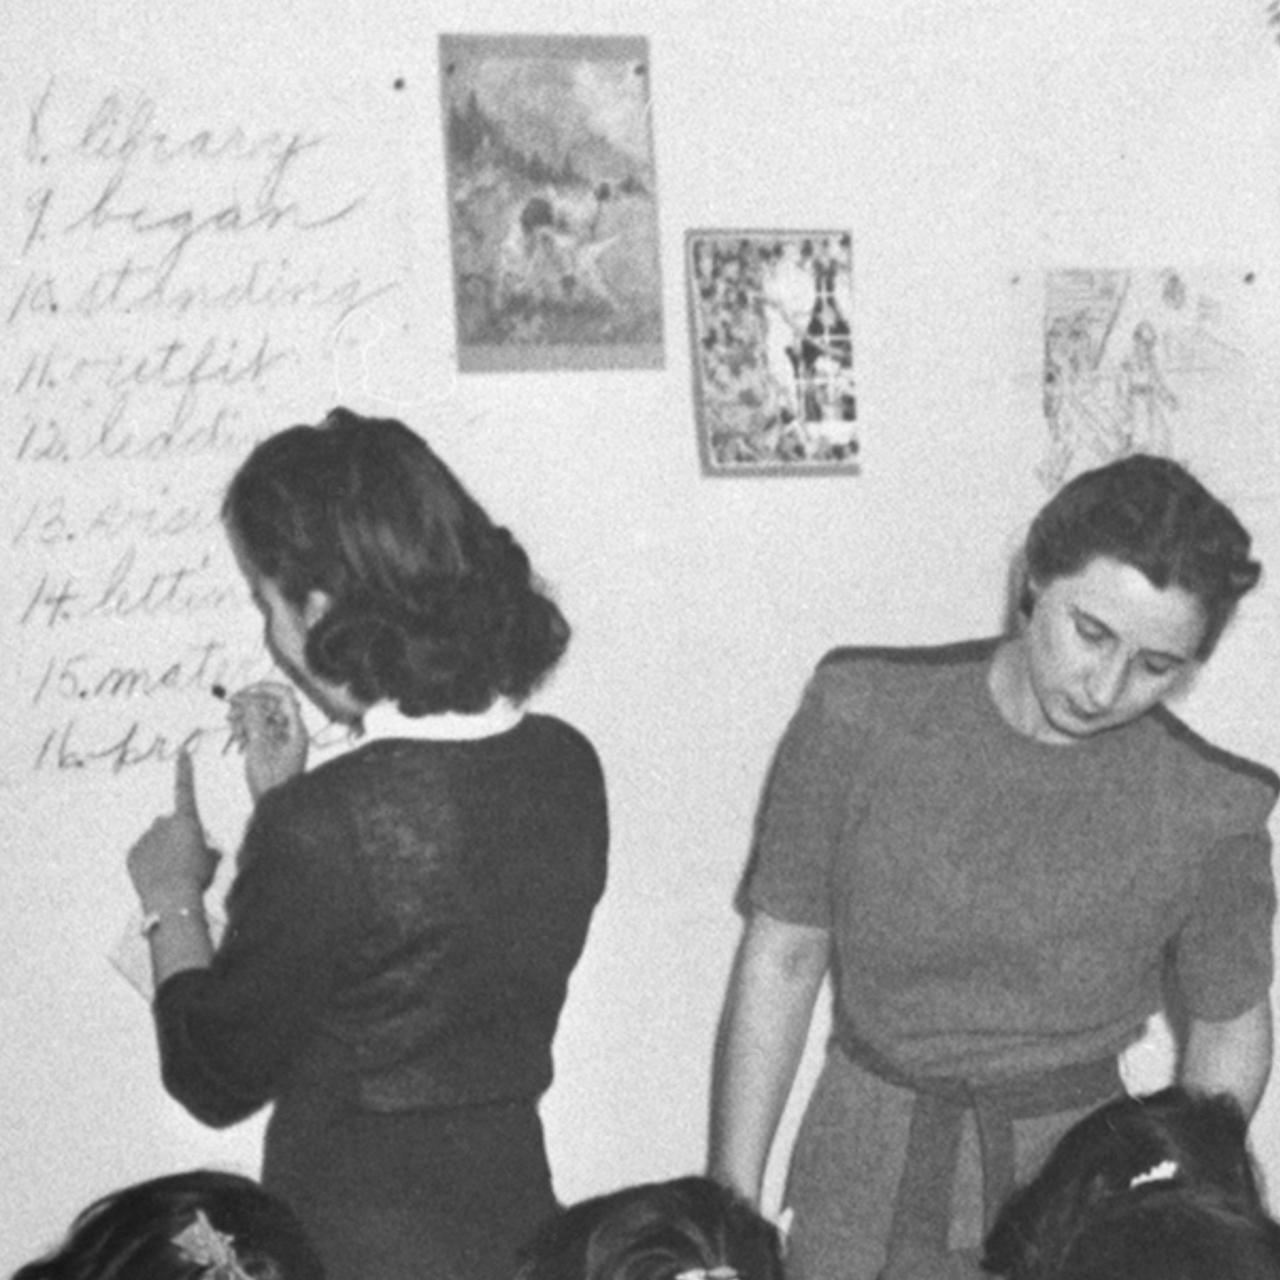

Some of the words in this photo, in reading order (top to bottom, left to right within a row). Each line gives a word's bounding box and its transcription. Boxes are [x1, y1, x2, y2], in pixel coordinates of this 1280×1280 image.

[72, 90, 333, 210] library
[64, 168, 374, 300] began
[7, 270, 59, 324] 10.
[14, 352, 57, 394] 11.
[68, 332, 296, 428] outfit
[16, 420, 70, 462] 12.
[12, 495, 76, 546] 13.
[20, 574, 75, 626] 14.
[33, 655, 88, 704] 15.
[34, 718, 86, 770] 16.
